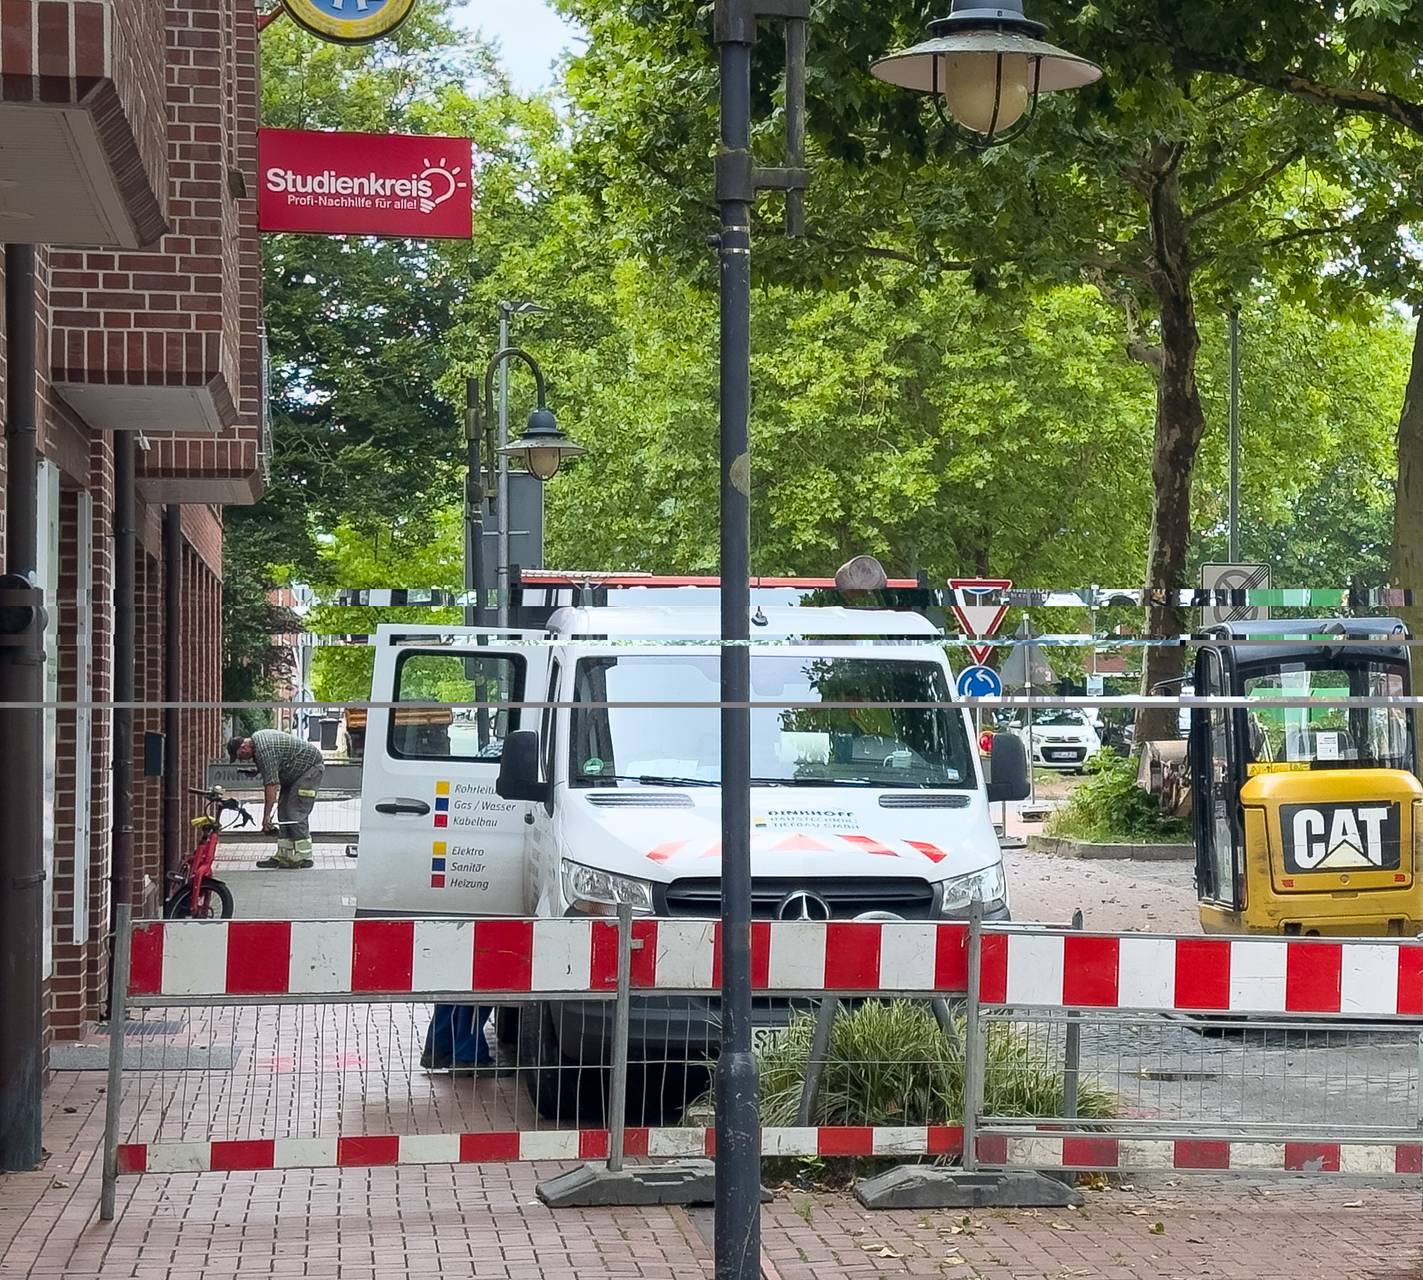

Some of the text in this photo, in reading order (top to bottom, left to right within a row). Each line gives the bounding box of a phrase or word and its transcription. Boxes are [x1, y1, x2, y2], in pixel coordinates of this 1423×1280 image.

[266, 167, 433, 197] Studienkreis
[287, 194, 417, 210] Profi-Nachhilfe für alle!
[454, 800, 473, 810] Gas
[481, 800, 517, 812] Wasser
[453, 815, 498, 827] Kabelbau
[1292, 807, 1388, 870] CAT
[451, 846, 485, 857] Elektro
[450, 861, 487, 873] Sanitär
[449, 879, 490, 892] Heizung
